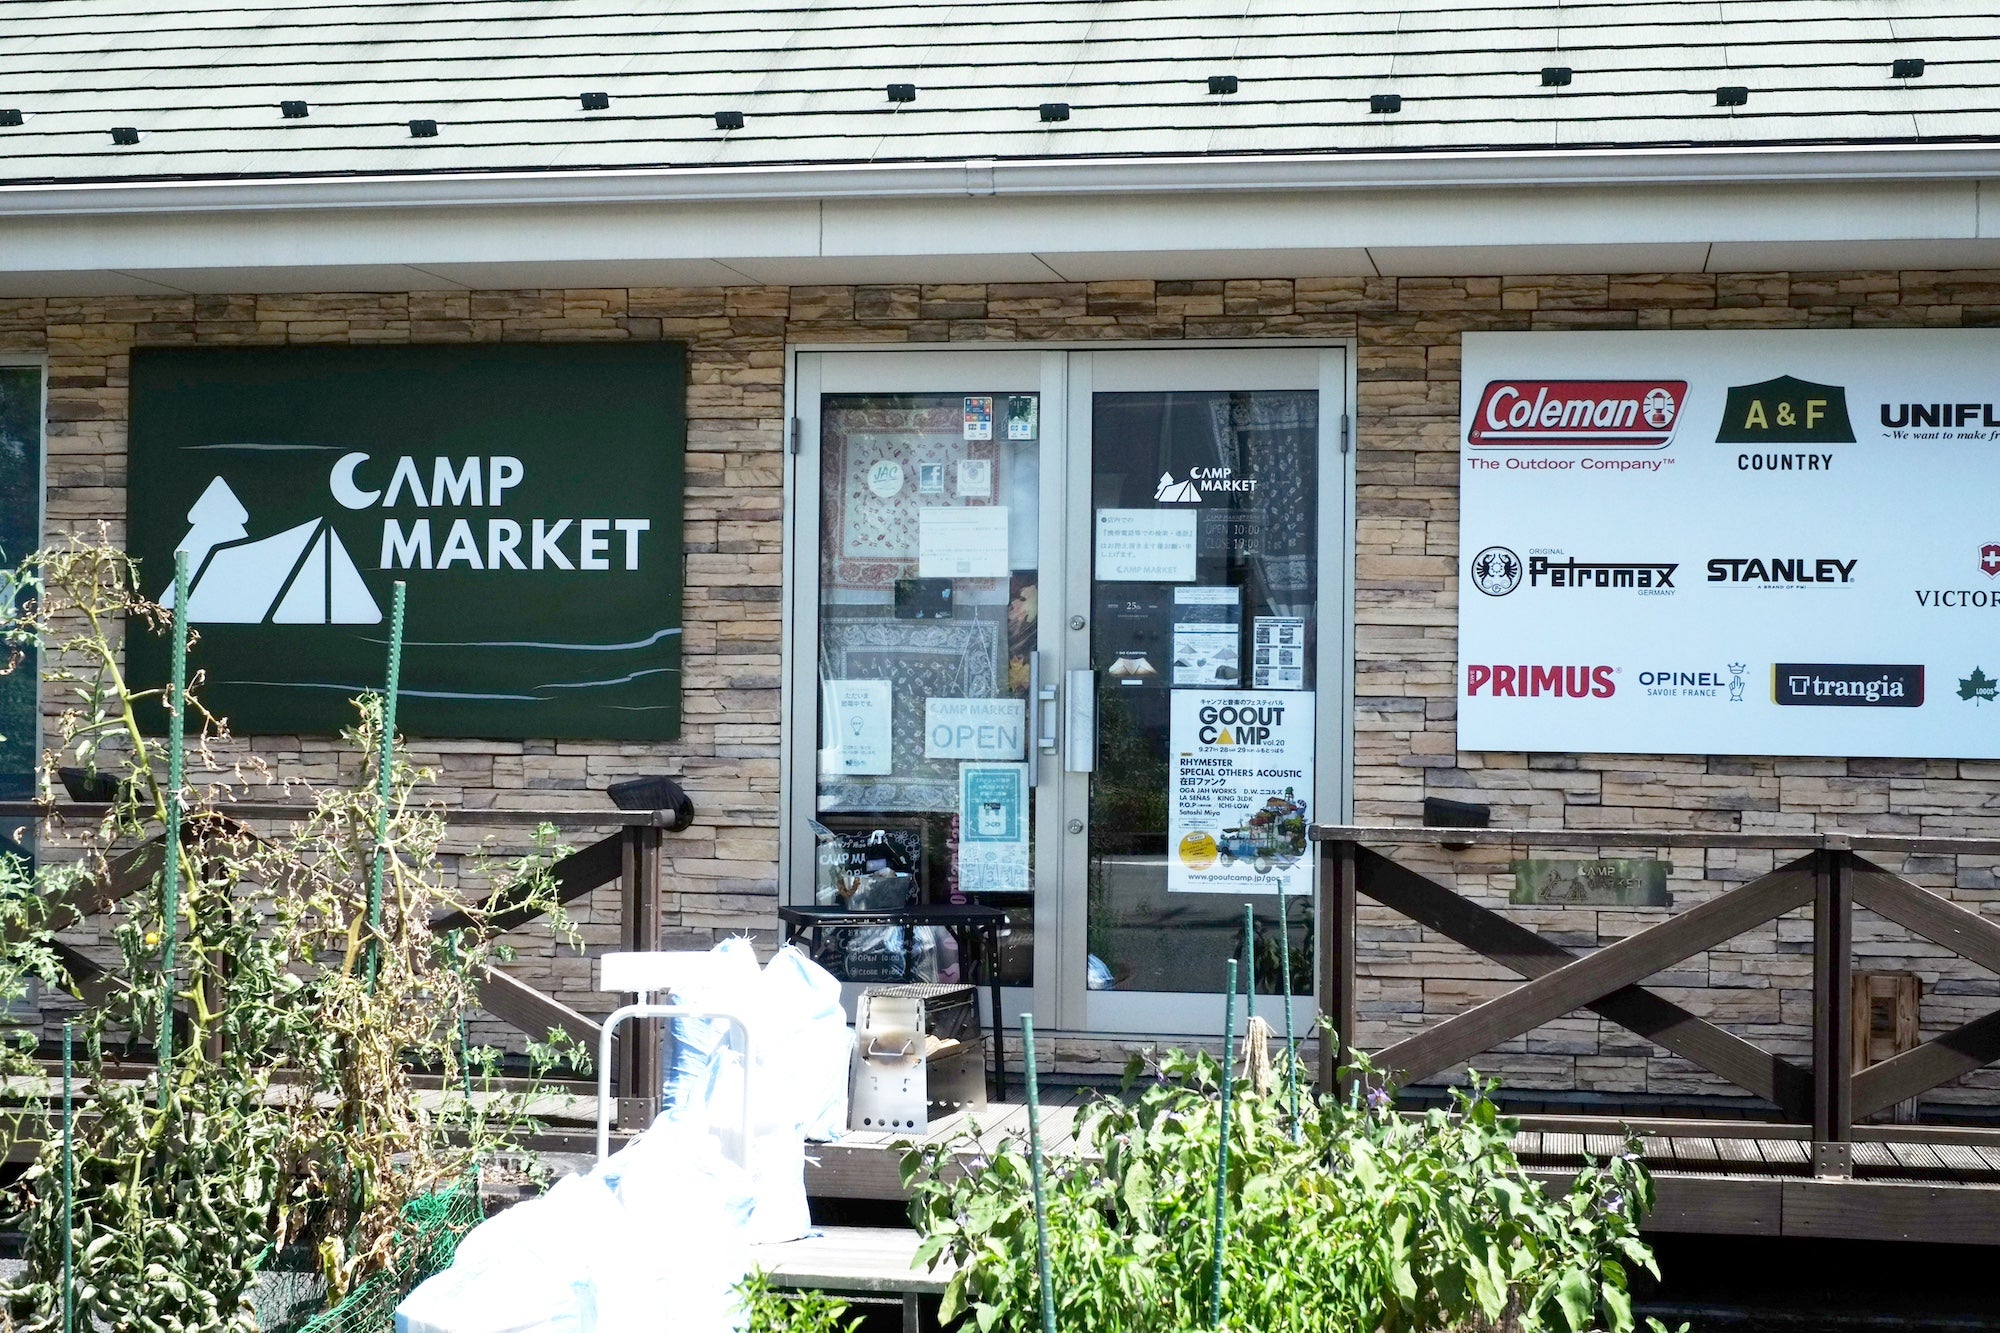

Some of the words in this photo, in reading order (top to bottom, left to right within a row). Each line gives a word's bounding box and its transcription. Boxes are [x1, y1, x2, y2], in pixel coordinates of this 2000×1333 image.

[1486, 386, 1640, 430] Coleman
[1744, 399, 1769, 429] A
[1776, 401, 1797, 427] &
[1806, 399, 1828, 429] F
[1913, 432, 1939, 440] want
[1943, 431, 1953, 440] to
[1957, 430, 1987, 440] make
[1467, 457, 1500, 470] The
[1505, 457, 1576, 470] Outdoor
[1737, 453, 1834, 471] COUNTRY
[1189, 466, 1232, 480] CAMP
[329, 451, 525, 510] CAMP
[1200, 479, 1258, 492] MARKET
[1234, 524, 1260, 535] 10:00
[379, 518, 651, 571] MARKET
[1233, 538, 1259, 550] 19:00
[1116, 565, 1142, 574] CAMP
[1143, 565, 1178, 574] MARKET
[1528, 556, 1680, 588] Petromax
[1706, 558, 1857, 583] STANLEY
[1637, 589, 1676, 597] GERMANY
[1467, 664, 1616, 699] PRIMUS
[1638, 671, 1726, 687] OPINEL
[1647, 688, 1677, 697] SAVOIE
[1682, 689, 1717, 697] FRANCE
[1812, 674, 1905, 703] trangia
[1975, 688, 1995, 696] LOGOS
[930, 703, 968, 714] CAMP
[969, 703, 1020, 716] MARKET
[931, 724, 1018, 750] OPEN
[1262, 739, 1286, 747] vol.20
[1179, 758, 1233, 767] RHYMESTER
[1179, 768, 1216, 777] SPECIAL
[1217, 769, 1254, 778] OTHERS
[1256, 769, 1303, 779] ACOUSTIC
[1179, 777, 1227, 787] 在日ファンク
[1203, 809, 1221, 817] Miya
